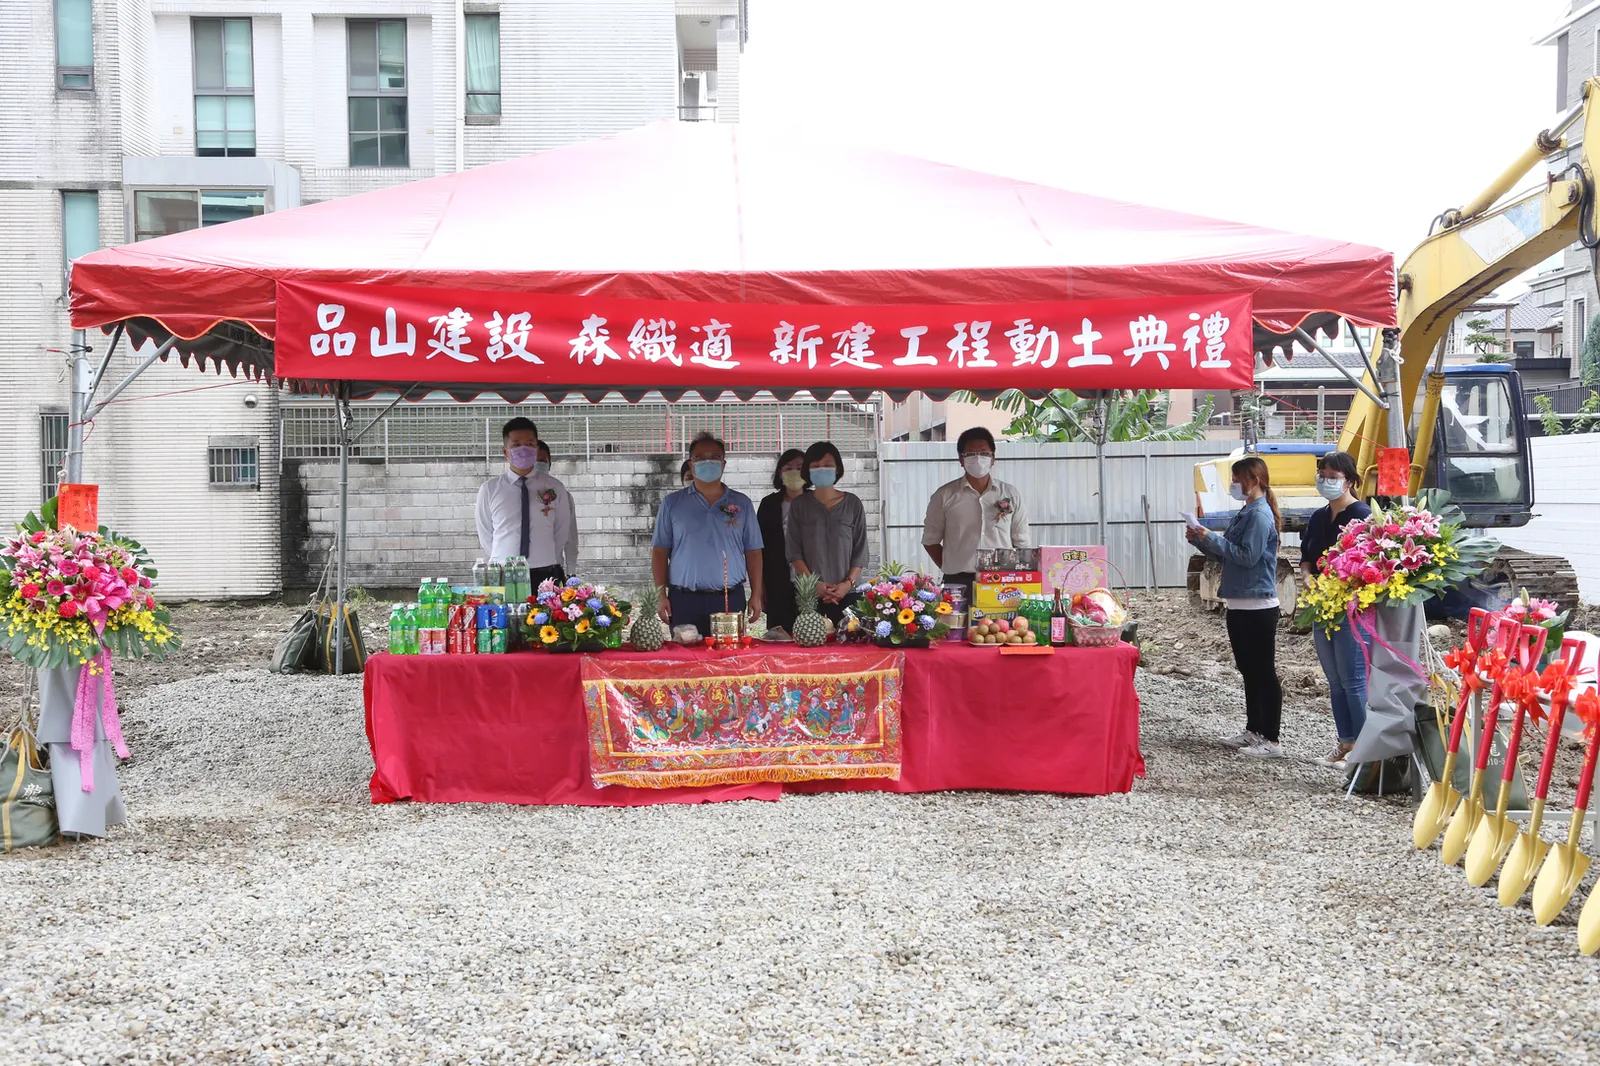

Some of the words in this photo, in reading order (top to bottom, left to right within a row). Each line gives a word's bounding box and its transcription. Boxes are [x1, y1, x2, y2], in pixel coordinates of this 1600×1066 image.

[311, 305, 545, 365] 品山建設
[569, 315, 741, 370] 森織適
[771, 312, 1232, 370] 新建工程動土典禮
